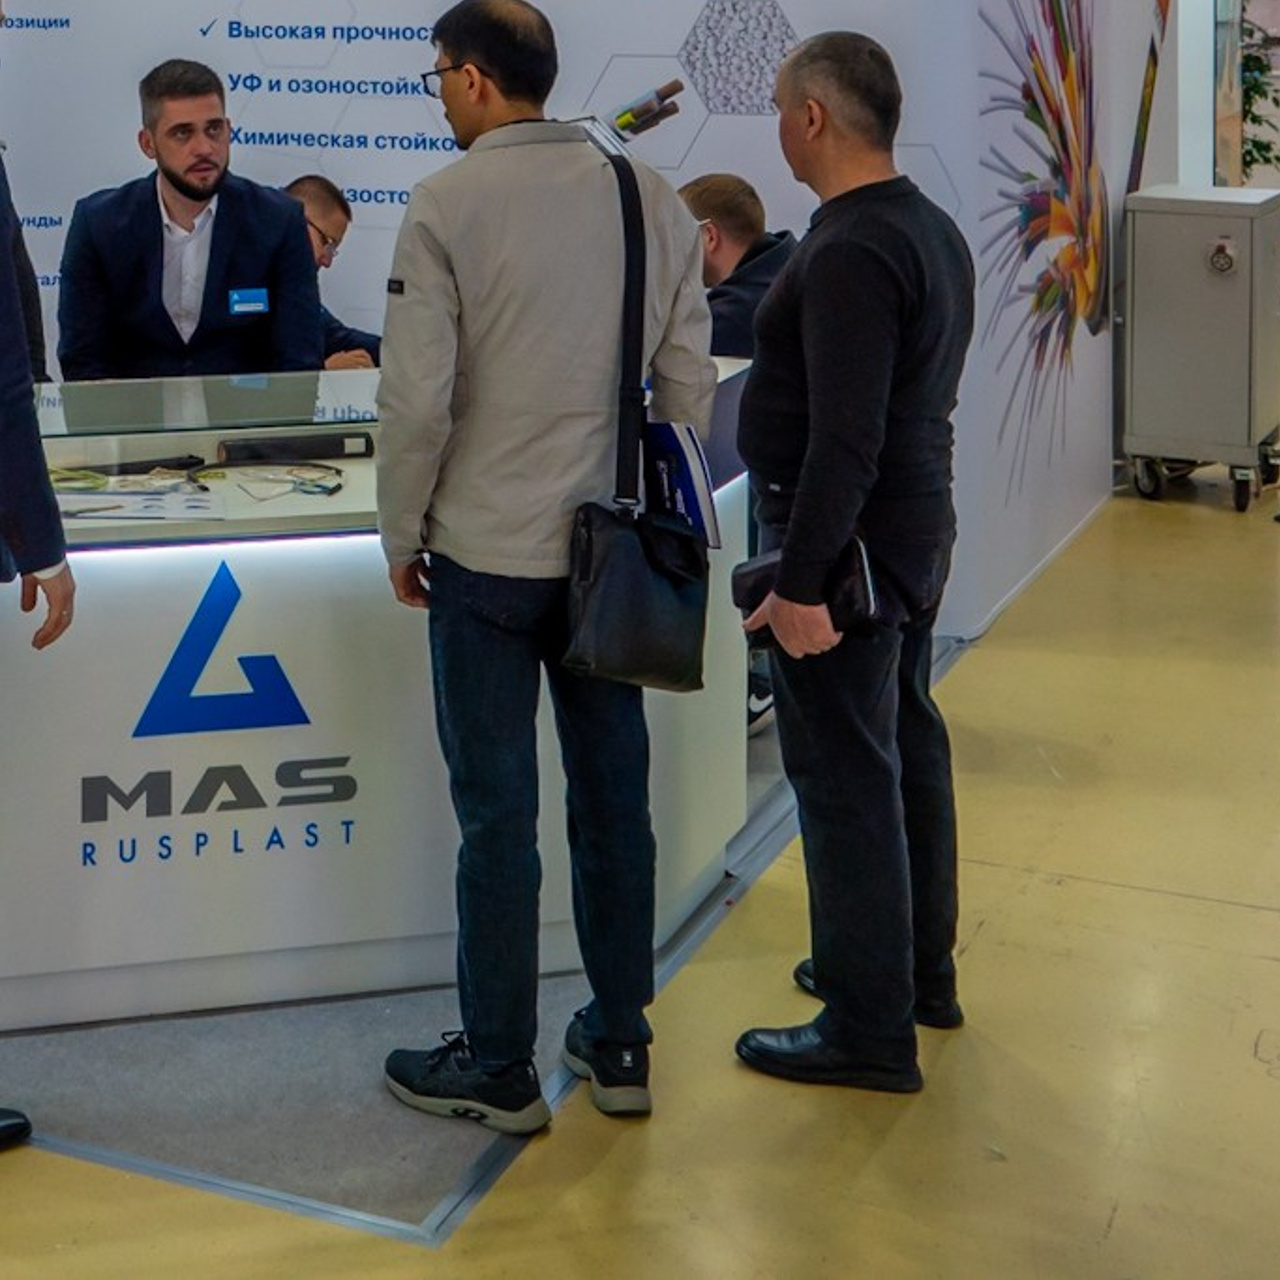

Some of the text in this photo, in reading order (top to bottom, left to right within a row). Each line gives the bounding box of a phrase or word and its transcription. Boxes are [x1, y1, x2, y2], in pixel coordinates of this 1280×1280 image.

[0, 17, 70, 30] озиции
[228, 21, 436, 44] Высокая прочнос
[228, 74, 426, 96] УФ и озоностойк
[230, 127, 457, 152] Химическая стойко
[81, 756, 358, 824] MAS
[81, 820, 356, 866] RUSPLAST
